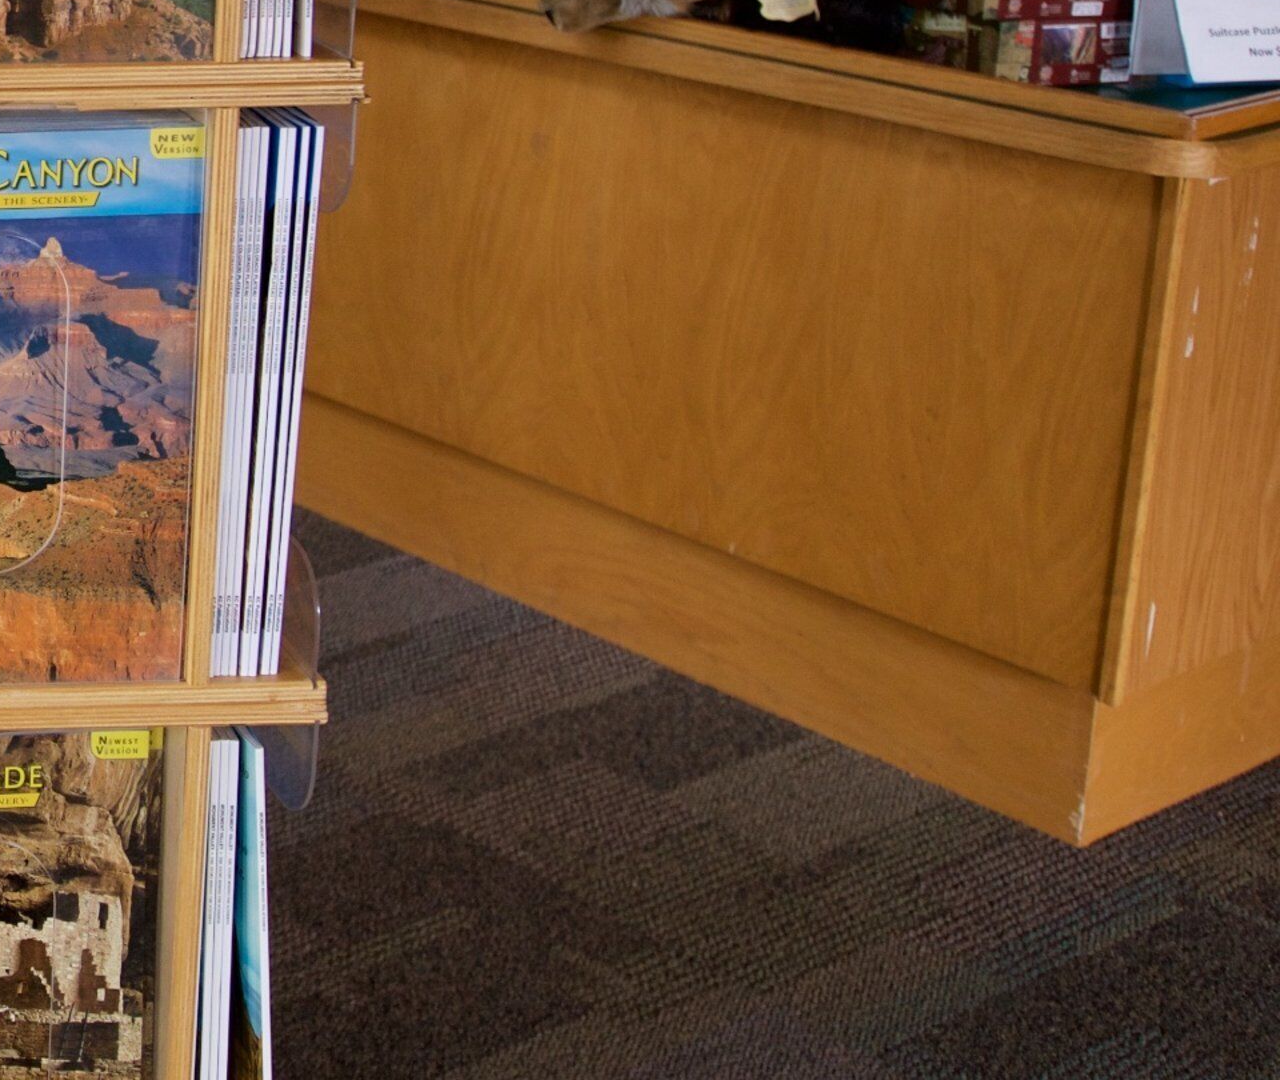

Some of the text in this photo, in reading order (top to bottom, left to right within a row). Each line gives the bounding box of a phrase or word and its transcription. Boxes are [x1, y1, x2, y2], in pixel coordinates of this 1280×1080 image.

[1209, 29, 1250, 38] Suitcase
[1249, 48, 1273, 56] Now
[158, 134, 195, 143] NEW
